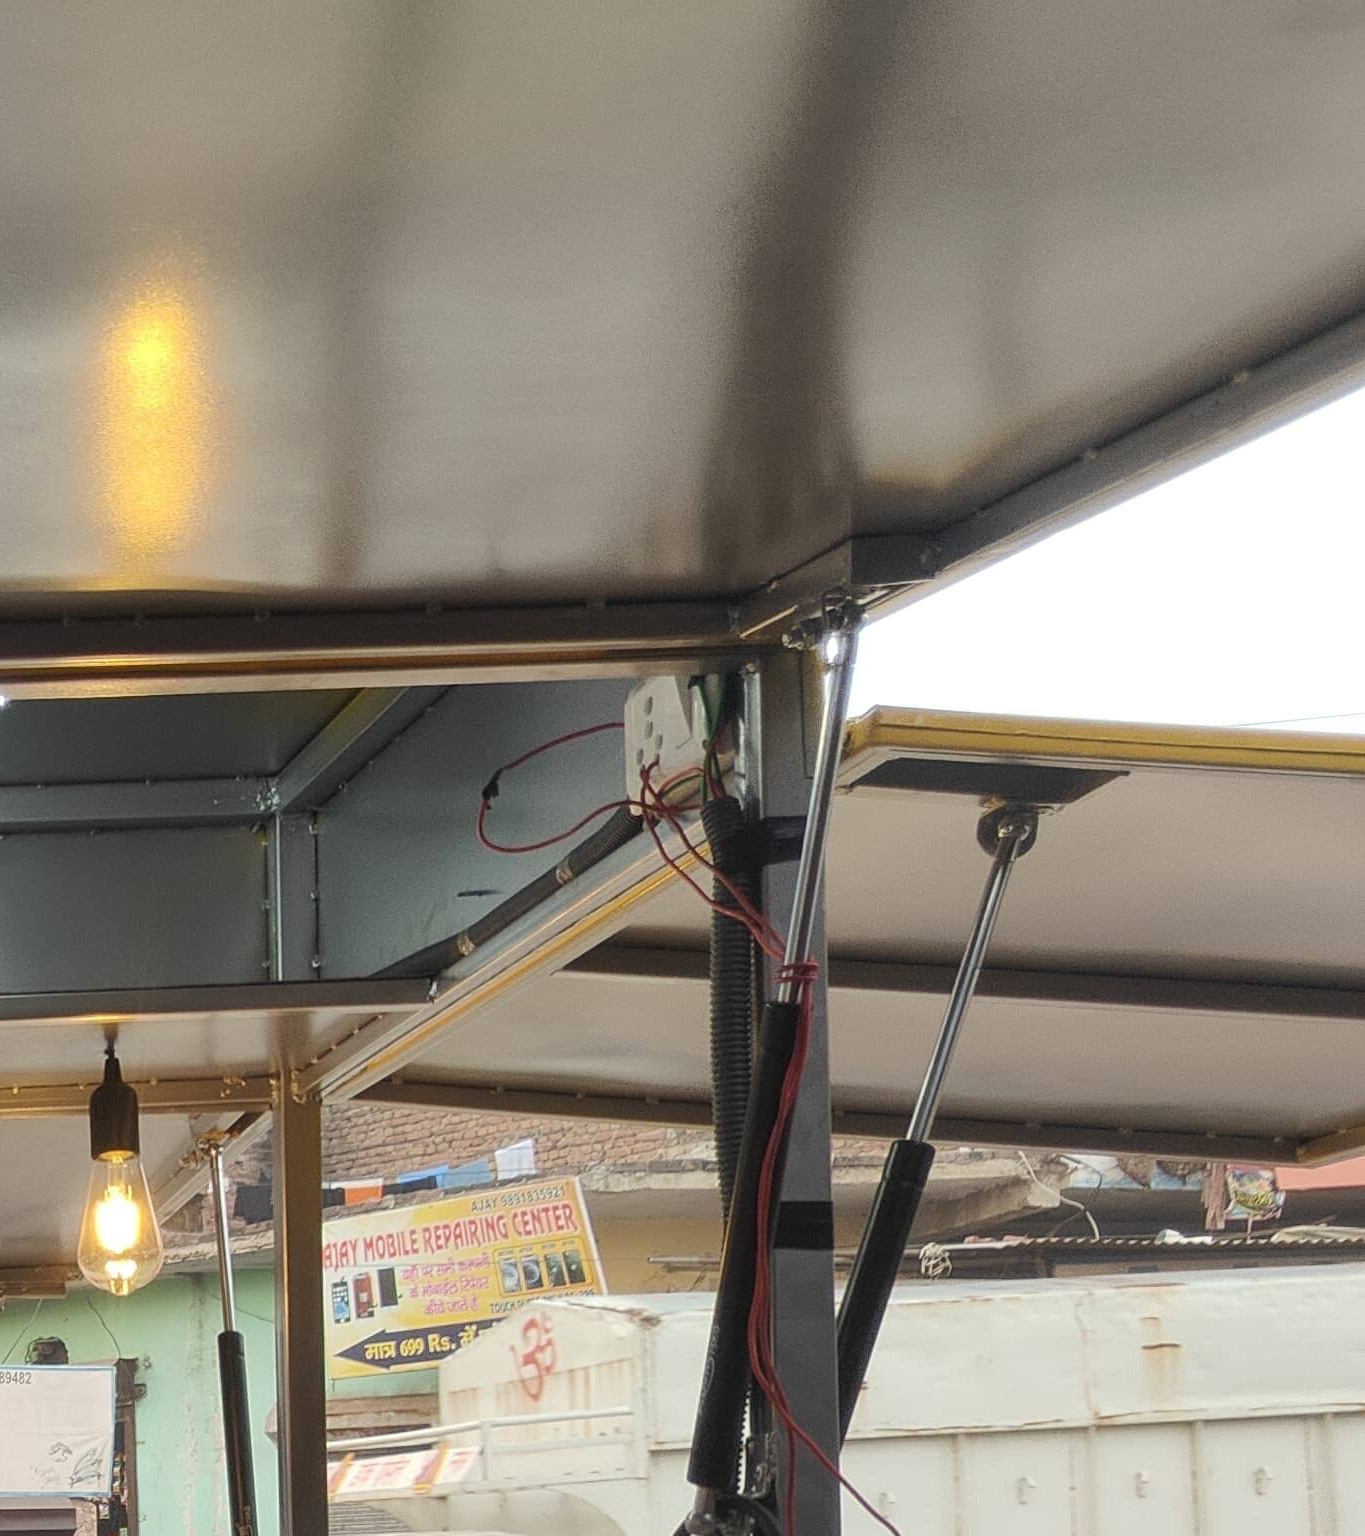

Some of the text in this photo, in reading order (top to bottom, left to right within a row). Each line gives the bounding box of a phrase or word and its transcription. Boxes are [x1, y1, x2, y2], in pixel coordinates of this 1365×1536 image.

[471, 1197, 497, 1212] AJAY
[323, 1204, 578, 1271] AJAY MOBILE REPAIRING CENTER
[400, 1338, 424, 1356] 699
[428, 1334, 456, 1353] Rs.
